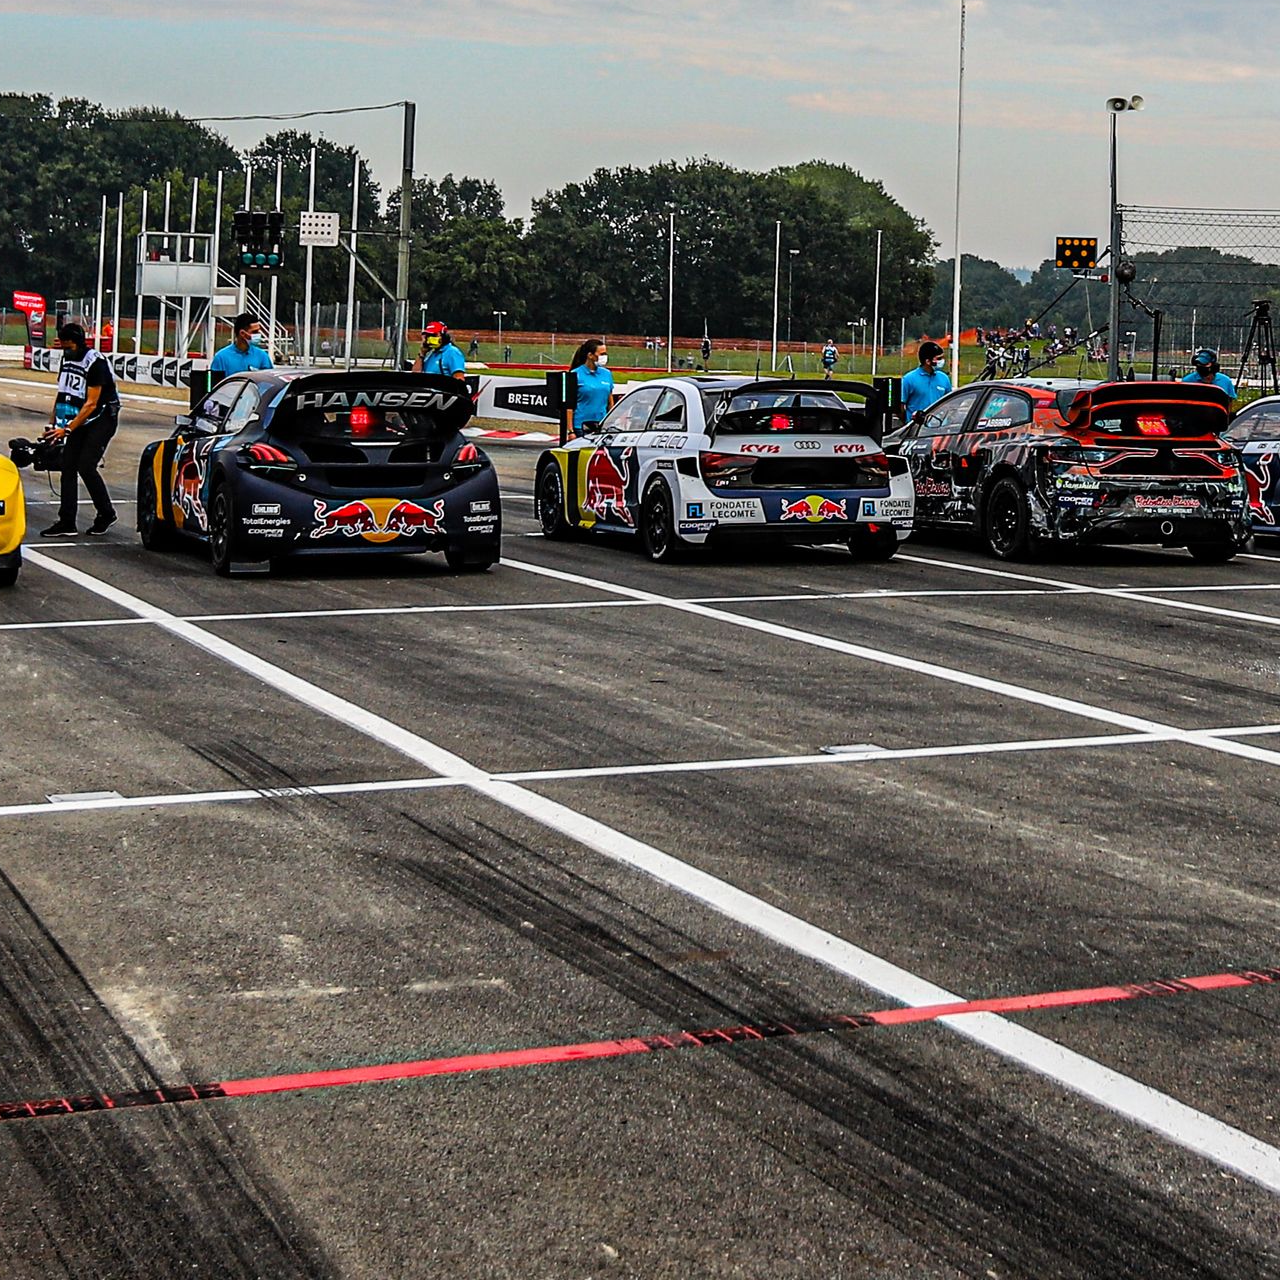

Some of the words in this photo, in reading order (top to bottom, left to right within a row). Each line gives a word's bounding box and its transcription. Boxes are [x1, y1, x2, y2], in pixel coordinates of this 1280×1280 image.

[296, 391, 458, 411] HANSEN
[740, 444, 781, 454] KYB
[833, 444, 866, 454] KYB
[710, 501, 758, 510] FONDATEL
[880, 500, 912, 508] FONDATEL
[712, 510, 756, 518] LECOMTE
[881, 509, 910, 517] LECOMTE
